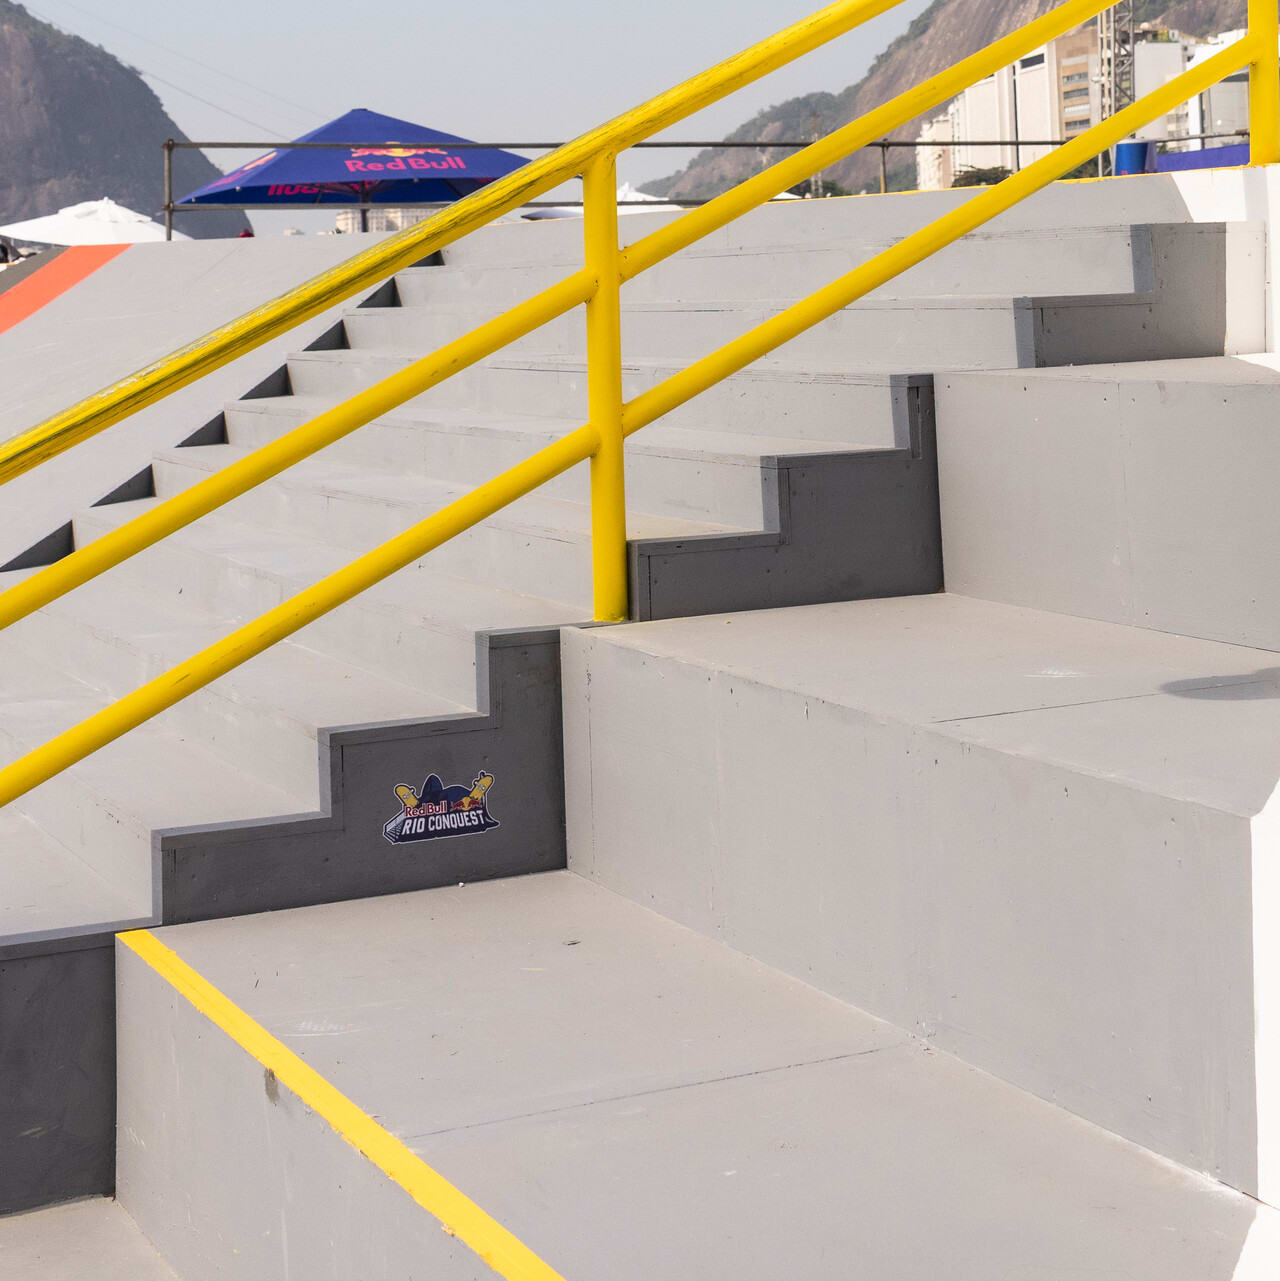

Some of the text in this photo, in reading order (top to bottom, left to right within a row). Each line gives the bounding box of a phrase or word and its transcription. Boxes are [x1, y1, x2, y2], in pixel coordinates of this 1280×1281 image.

[344, 156, 466, 173] Red Bull
[405, 801, 448, 817] Red Bull
[401, 810, 485, 835] RIO CONQUEST
